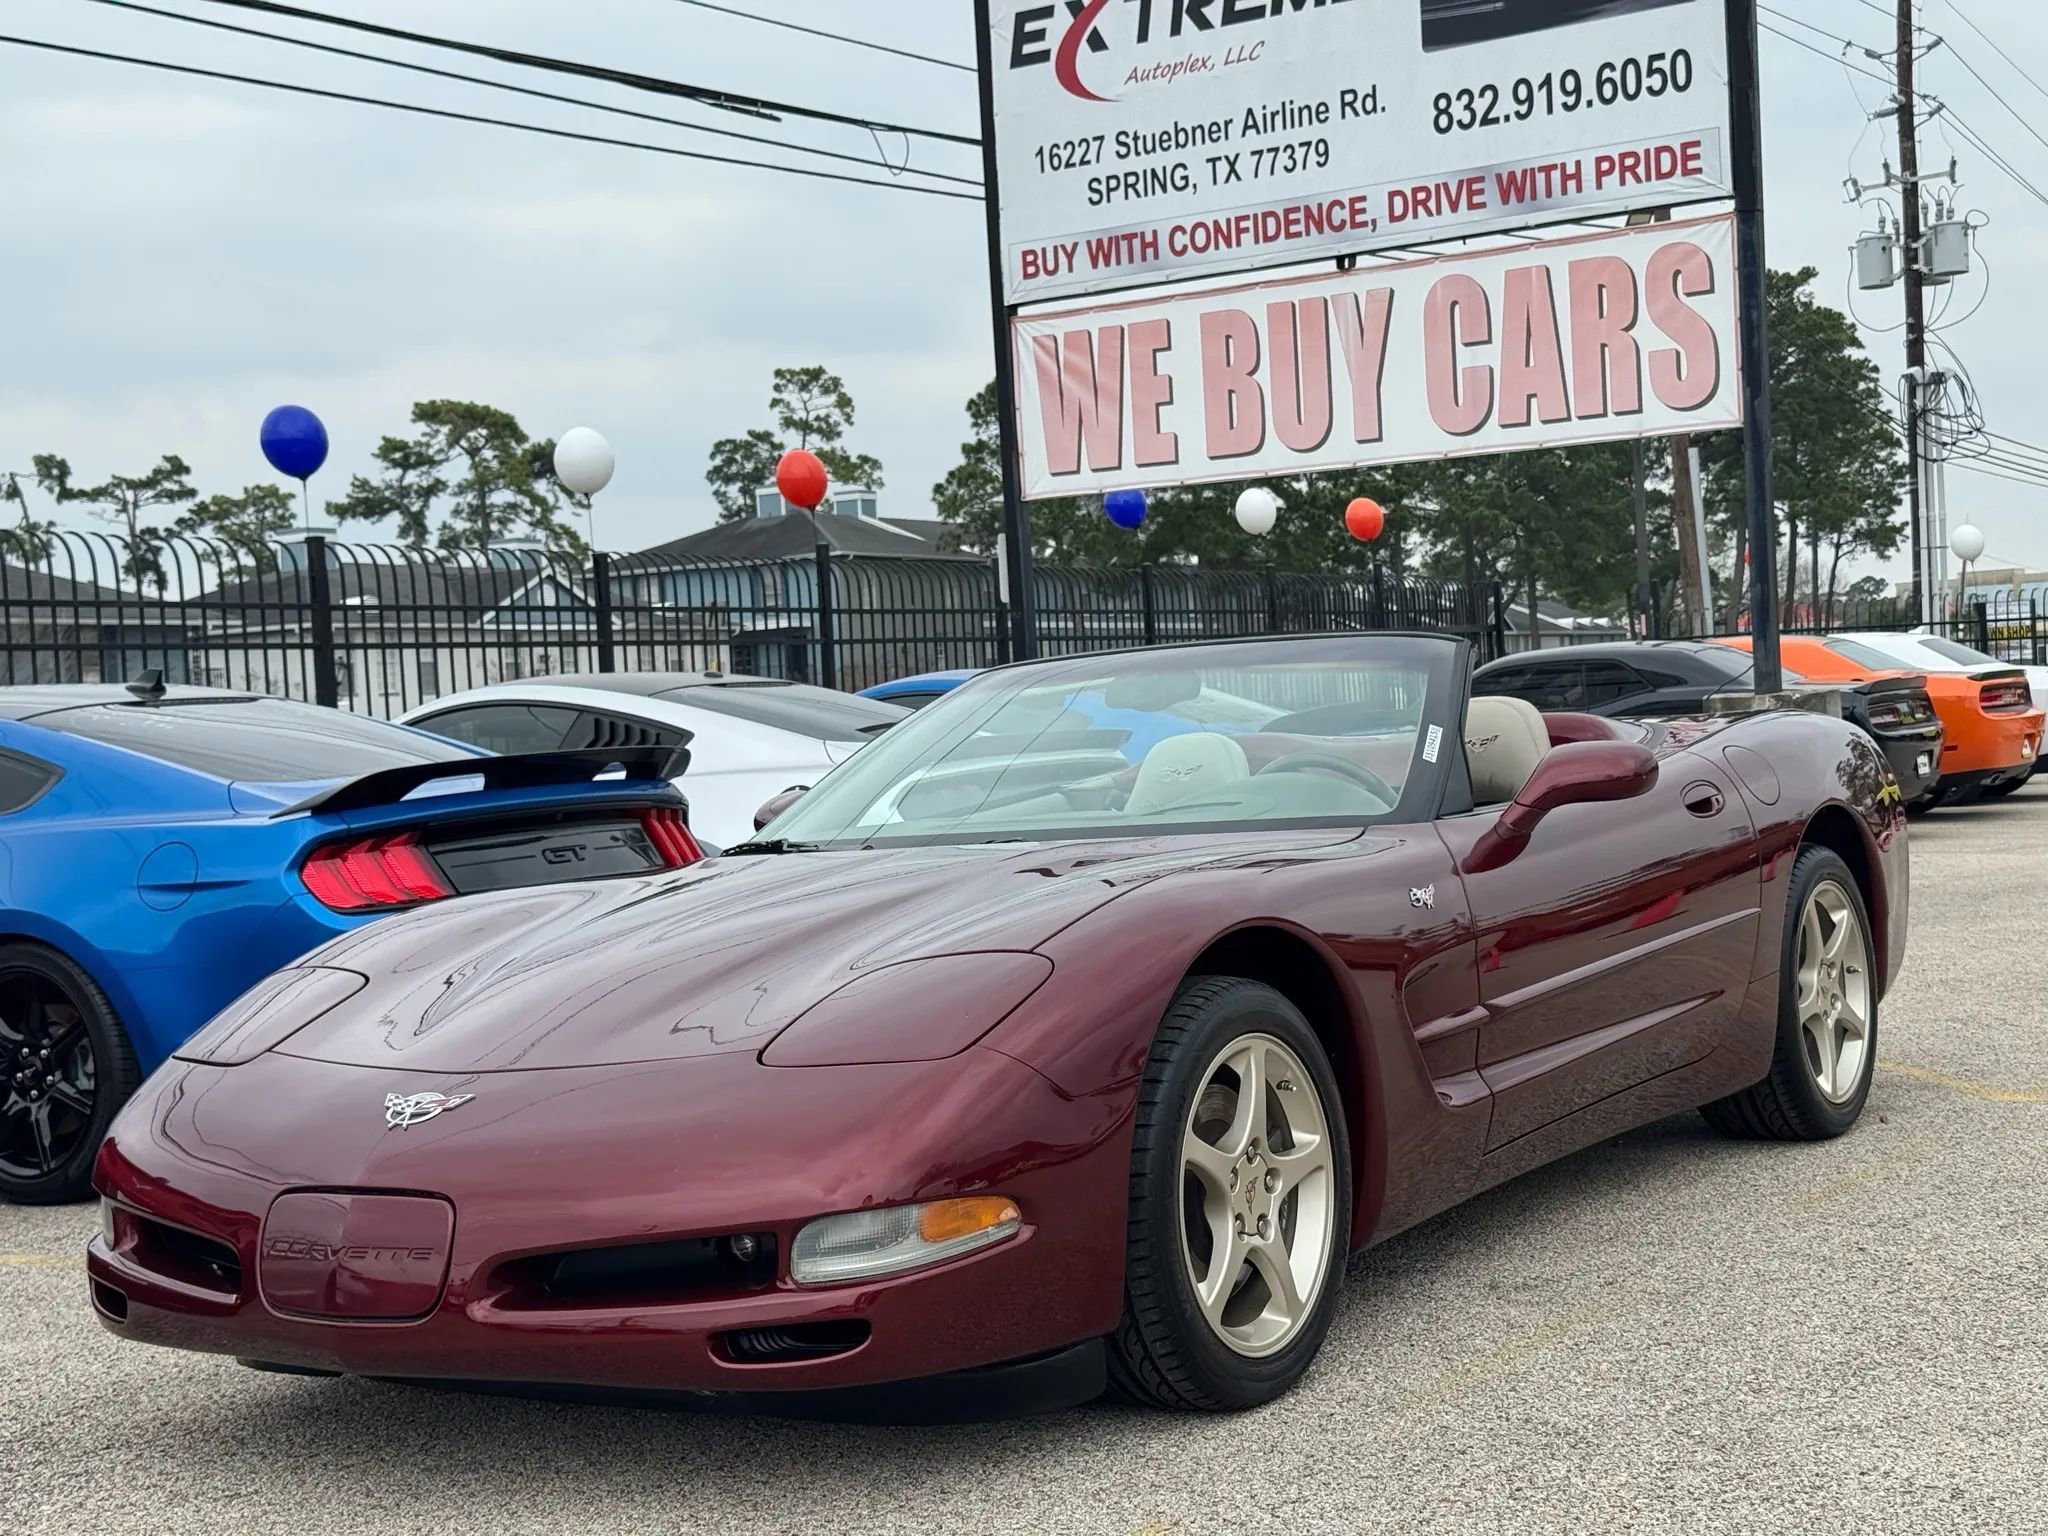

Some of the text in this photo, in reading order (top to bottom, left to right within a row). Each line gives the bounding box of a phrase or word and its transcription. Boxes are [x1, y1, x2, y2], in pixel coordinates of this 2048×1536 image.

[1010, 0, 1358, 101] EXTR
[1123, 40, 1265, 86] Autoplex, LLC
[1433, 48, 1692, 135] 832.919.6050
[1035, 84, 1386, 174] 16227 Stuebner Airline Rd.
[1088, 138, 1330, 207] SPRING, TX 77379
[1022, 140, 1703, 280] BUY WITH CONFIDENCE, DRIVE WITH PRIDE
[1032, 241, 1720, 477] WE BUY CARS
[542, 844, 587, 865] GT
[267, 1239, 434, 1261] CORVETTE
